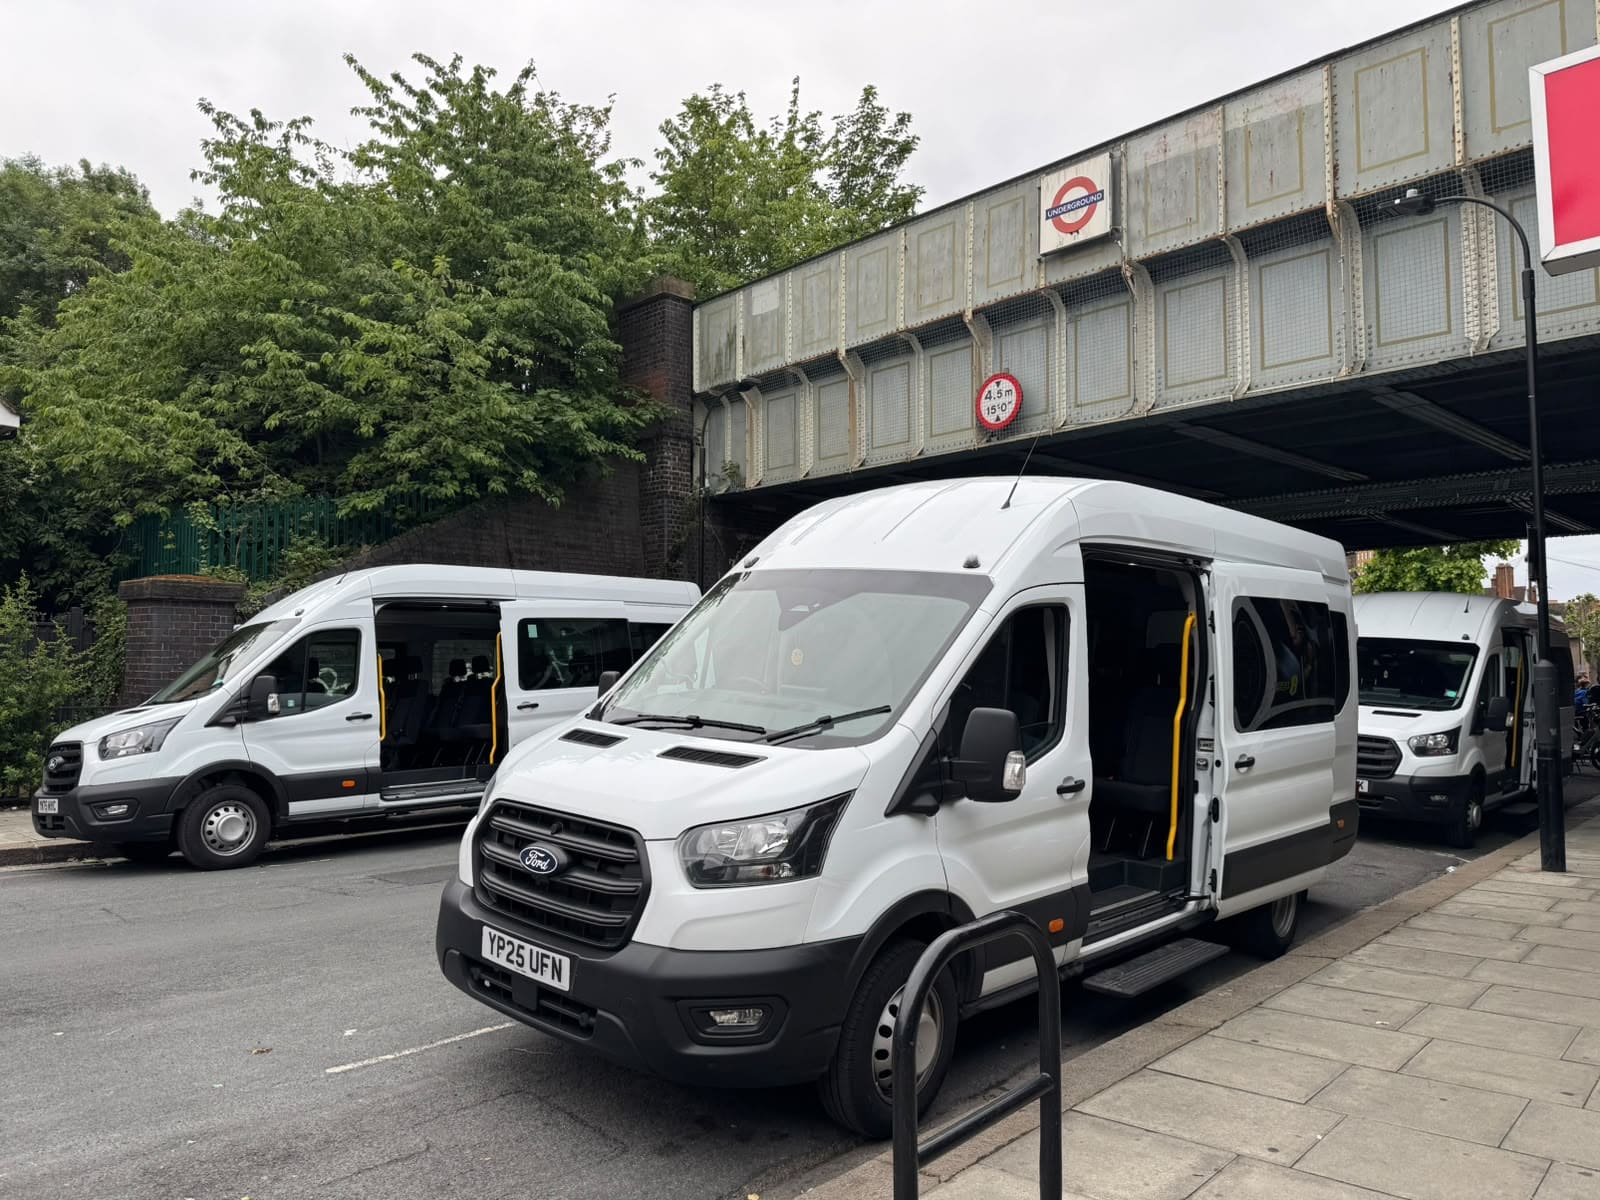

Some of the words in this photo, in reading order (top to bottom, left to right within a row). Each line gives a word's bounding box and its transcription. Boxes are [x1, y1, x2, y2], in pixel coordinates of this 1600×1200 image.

[1047, 193, 1102, 217] UNDERGROUND
[985, 389, 1003, 400] 4.5
[525, 850, 550, 870] Ford
[488, 931, 525, 968] YP25
[529, 948, 562, 983] UFN
